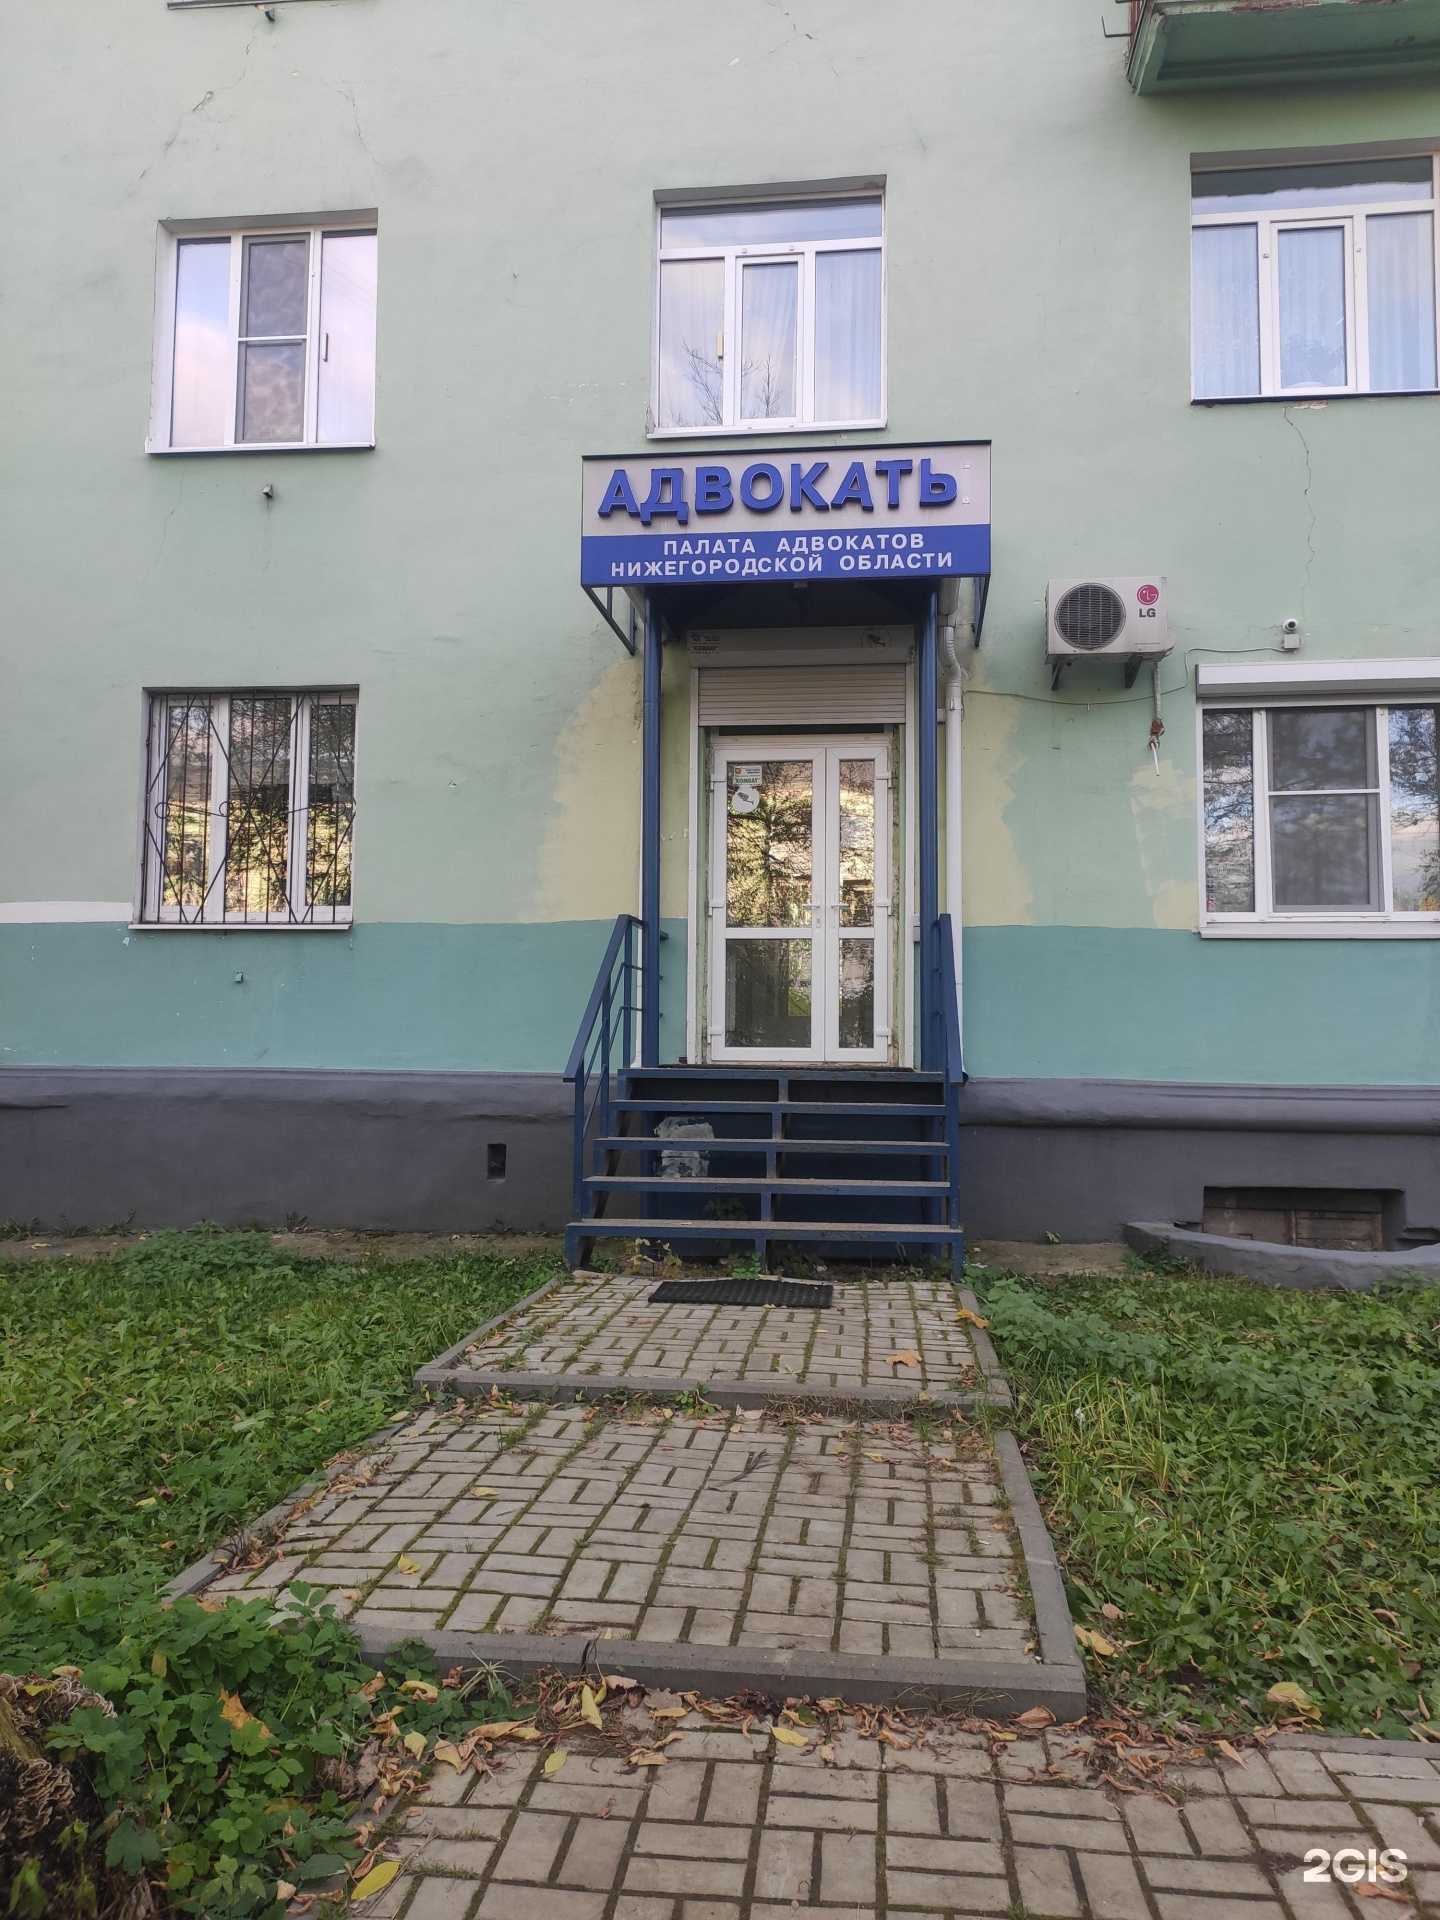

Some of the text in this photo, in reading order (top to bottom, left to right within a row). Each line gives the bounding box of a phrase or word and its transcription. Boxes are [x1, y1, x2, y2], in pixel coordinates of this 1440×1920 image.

[597, 457, 958, 526] АДВОКАТЬ
[663, 532, 925, 556] ПАЛАТА АДВОКАТОВ
[610, 551, 953, 577] НИЖЕГОРОДСКОЙ ОБЛАСТИ
[1138, 607, 1157, 618] LG
